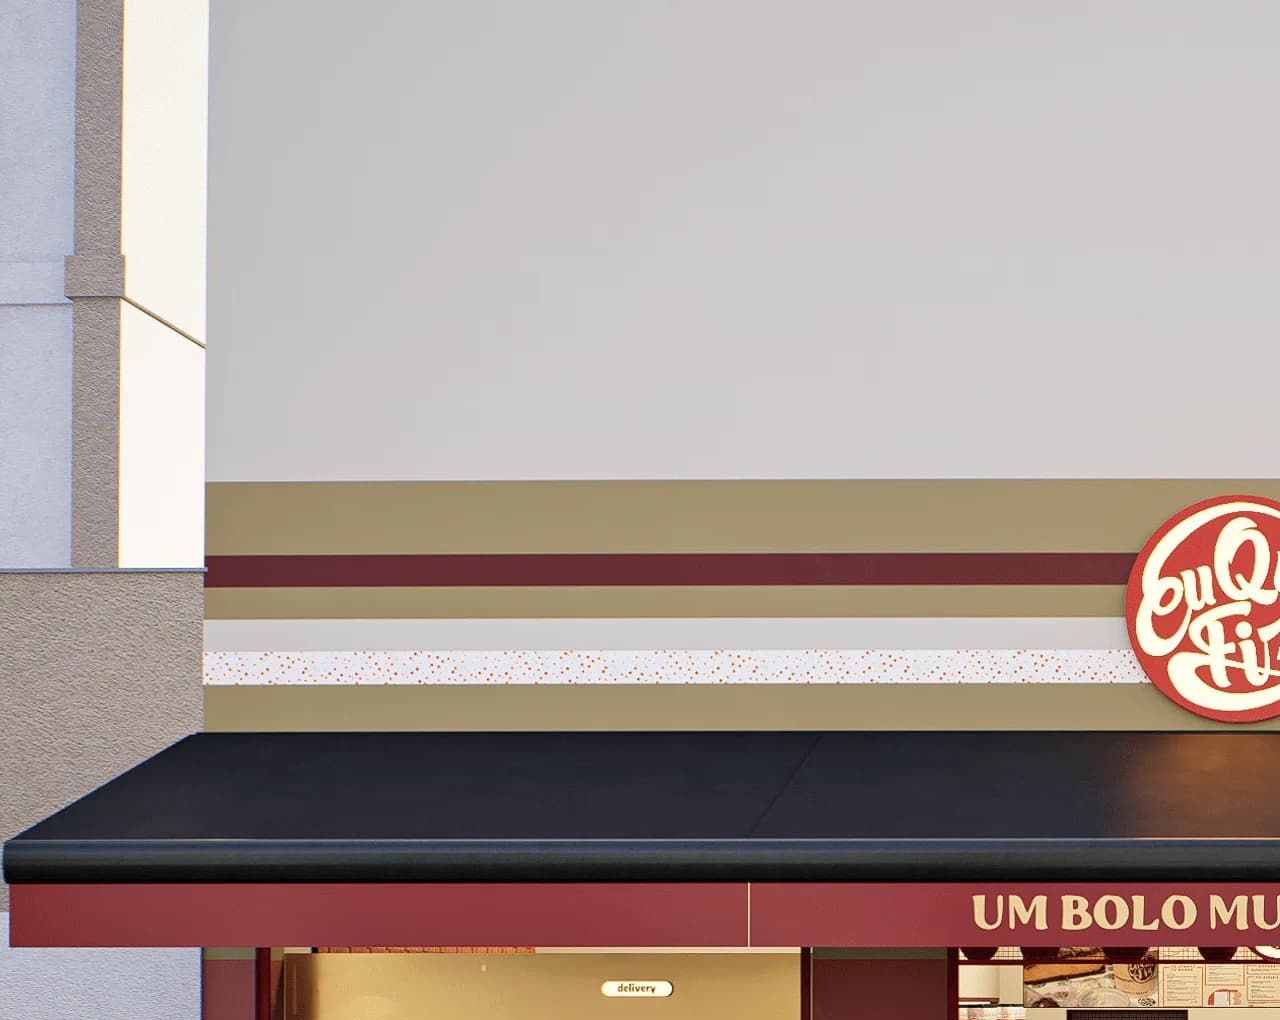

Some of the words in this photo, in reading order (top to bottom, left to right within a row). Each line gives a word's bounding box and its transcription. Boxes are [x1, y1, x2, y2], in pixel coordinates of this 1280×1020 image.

[972, 895, 1048, 931] UM
[1061, 895, 1198, 931] BOLO
[617, 984, 656, 994] delivery
